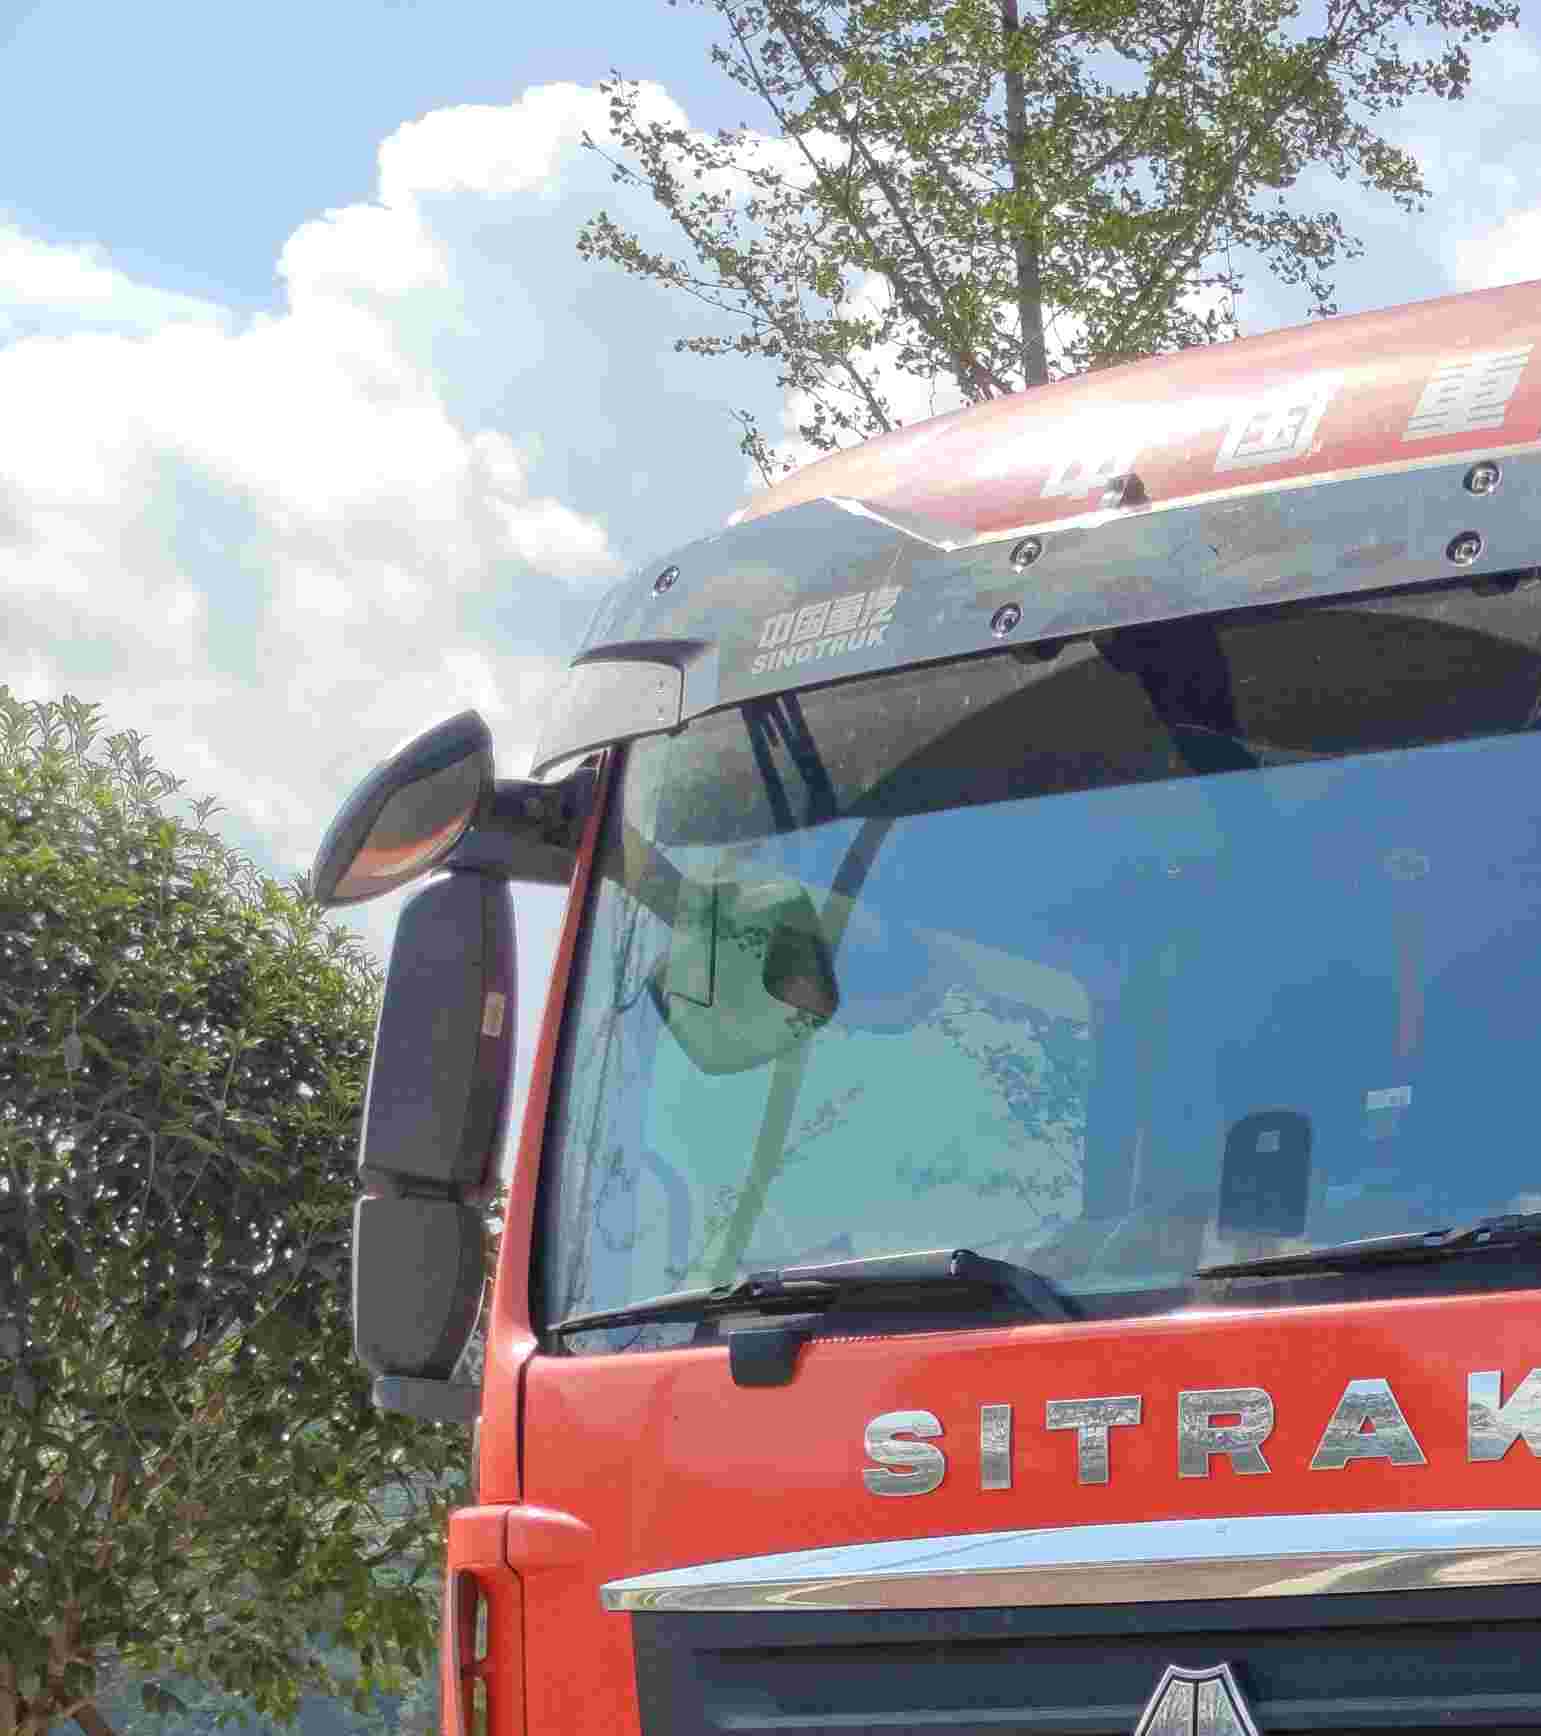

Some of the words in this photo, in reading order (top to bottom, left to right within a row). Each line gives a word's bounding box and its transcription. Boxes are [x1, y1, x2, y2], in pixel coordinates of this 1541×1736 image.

[757, 583, 904, 648] 中国重汽
[751, 622, 889, 676] SINOTRUK
